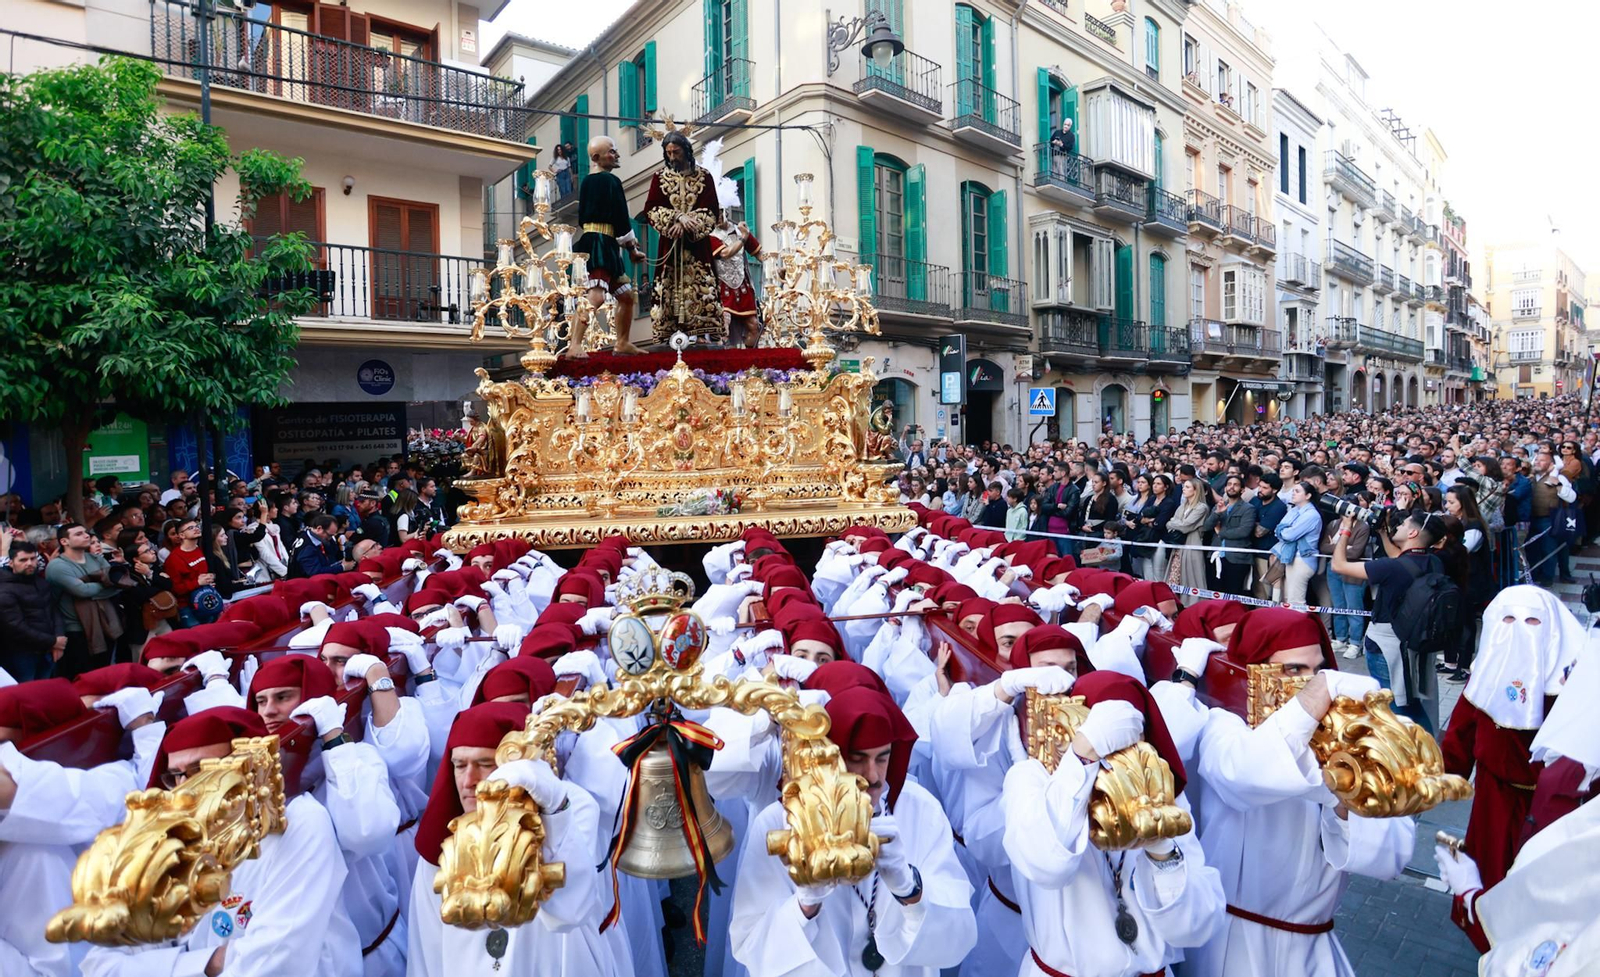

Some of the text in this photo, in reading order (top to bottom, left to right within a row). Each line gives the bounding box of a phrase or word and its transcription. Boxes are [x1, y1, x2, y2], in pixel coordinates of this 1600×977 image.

[945, 374, 955, 389] P
[277, 413, 396, 425] Centro de FISIOTERAPIA
[278, 427, 397, 439] OSTEOPATÍA PILATES
